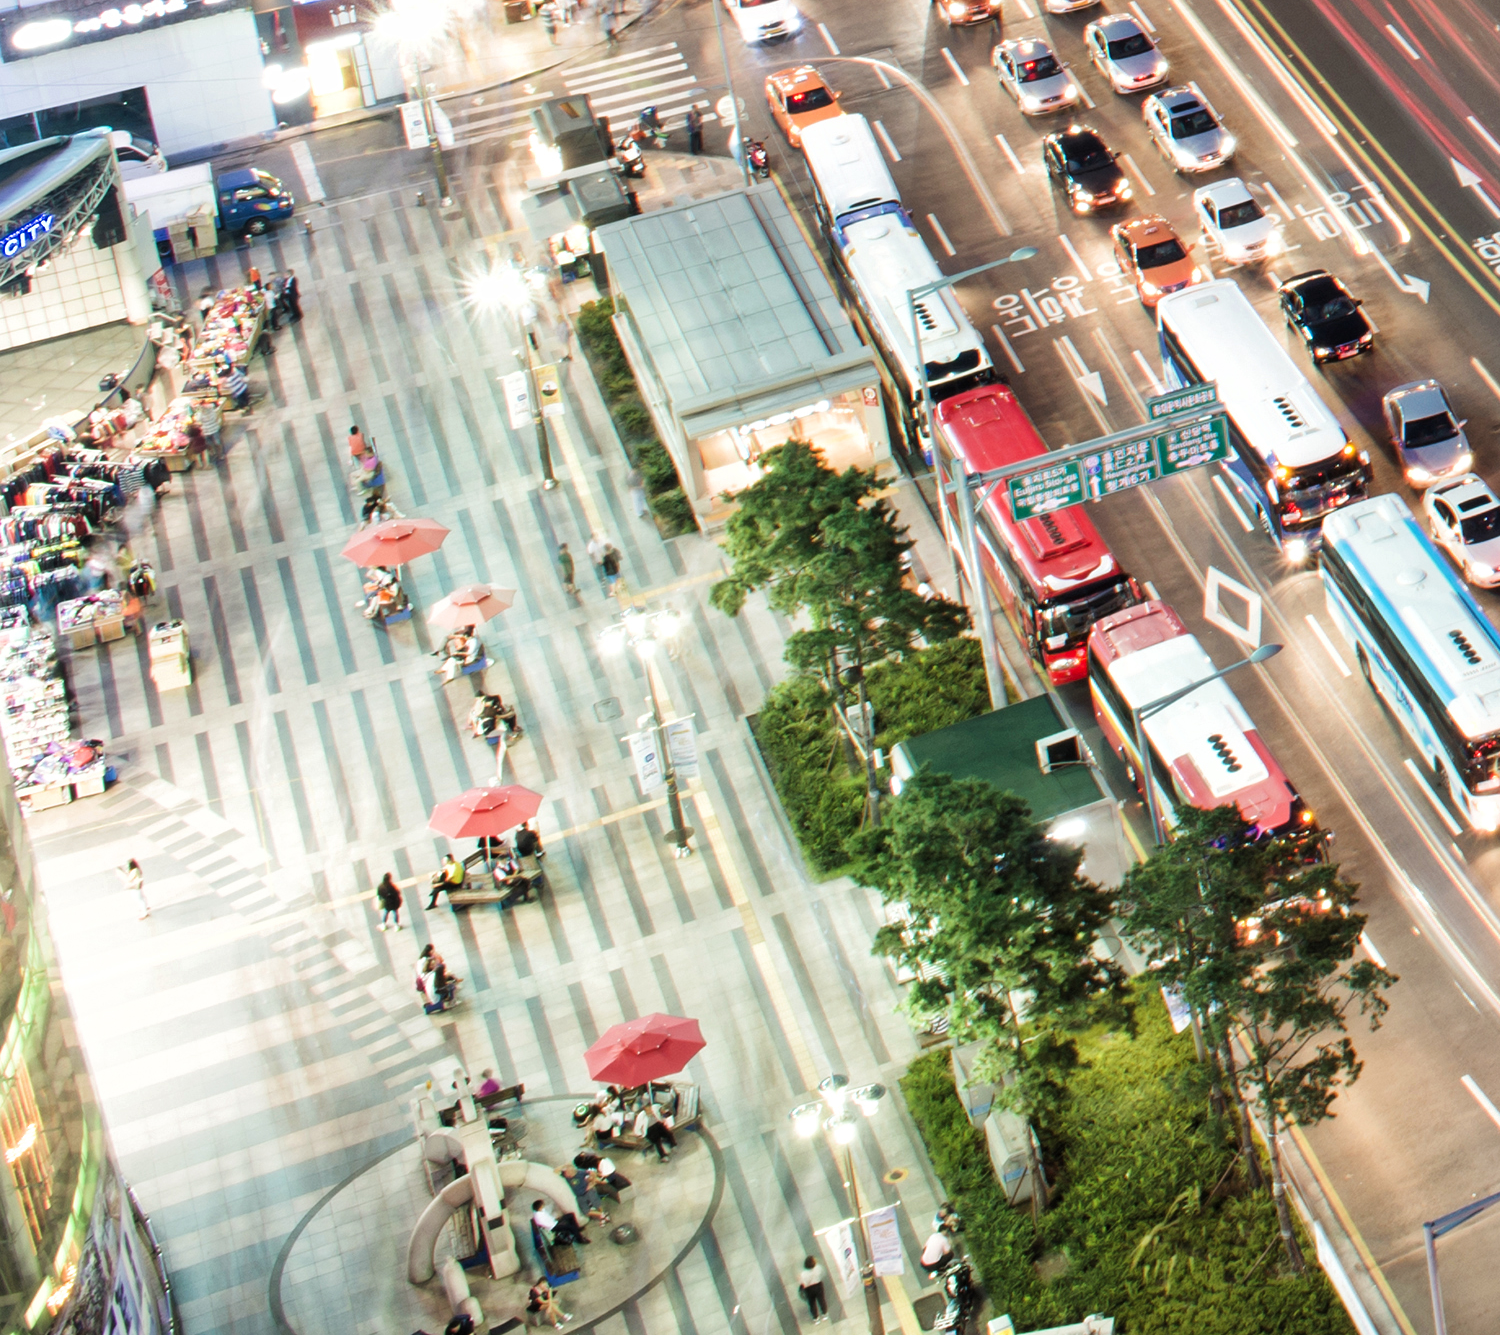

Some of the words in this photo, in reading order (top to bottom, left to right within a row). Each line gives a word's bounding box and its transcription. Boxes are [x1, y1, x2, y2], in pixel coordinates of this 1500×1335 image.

[3, 214, 54, 257] CITY
[992, 275, 1098, 338] 광희동
[1180, 422, 1212, 440] 신당역
